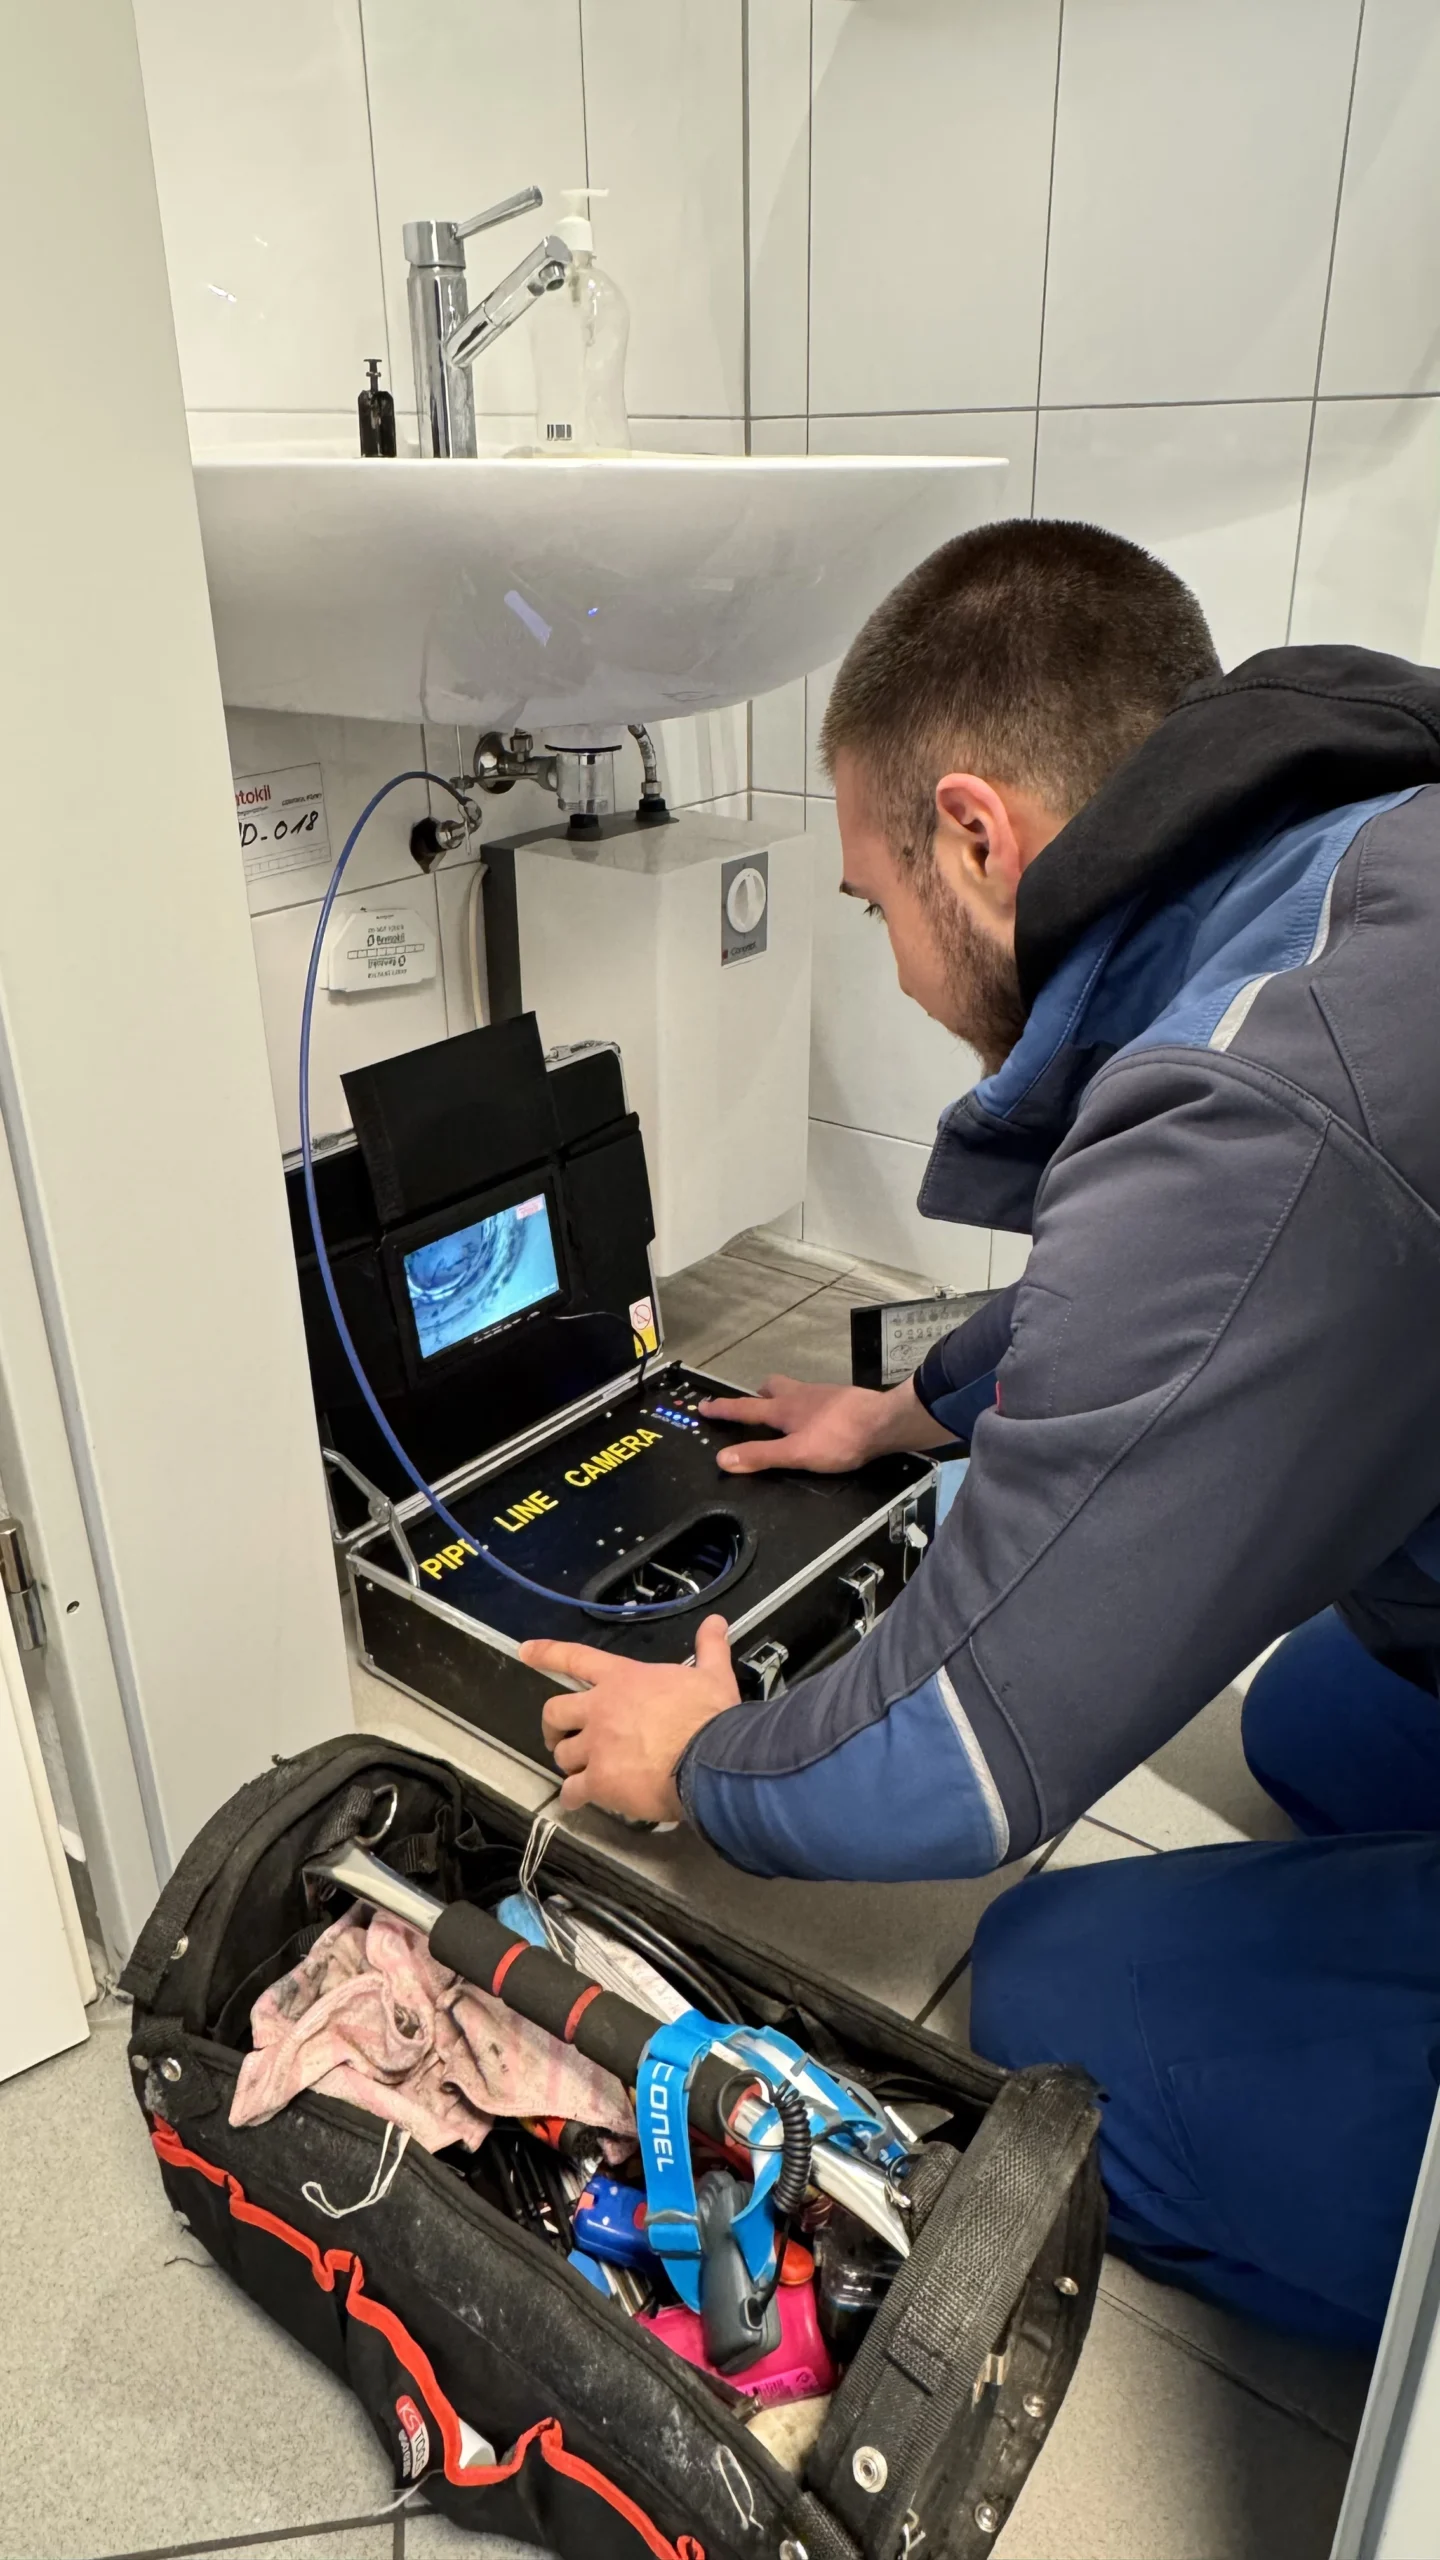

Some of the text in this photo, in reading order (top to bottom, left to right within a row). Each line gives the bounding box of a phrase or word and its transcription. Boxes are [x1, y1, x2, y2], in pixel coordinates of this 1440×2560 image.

[493, 1490, 559, 1532] LINE
[564, 1428, 663, 1488] CAMERA
[398, 2403, 421, 2431] KS
